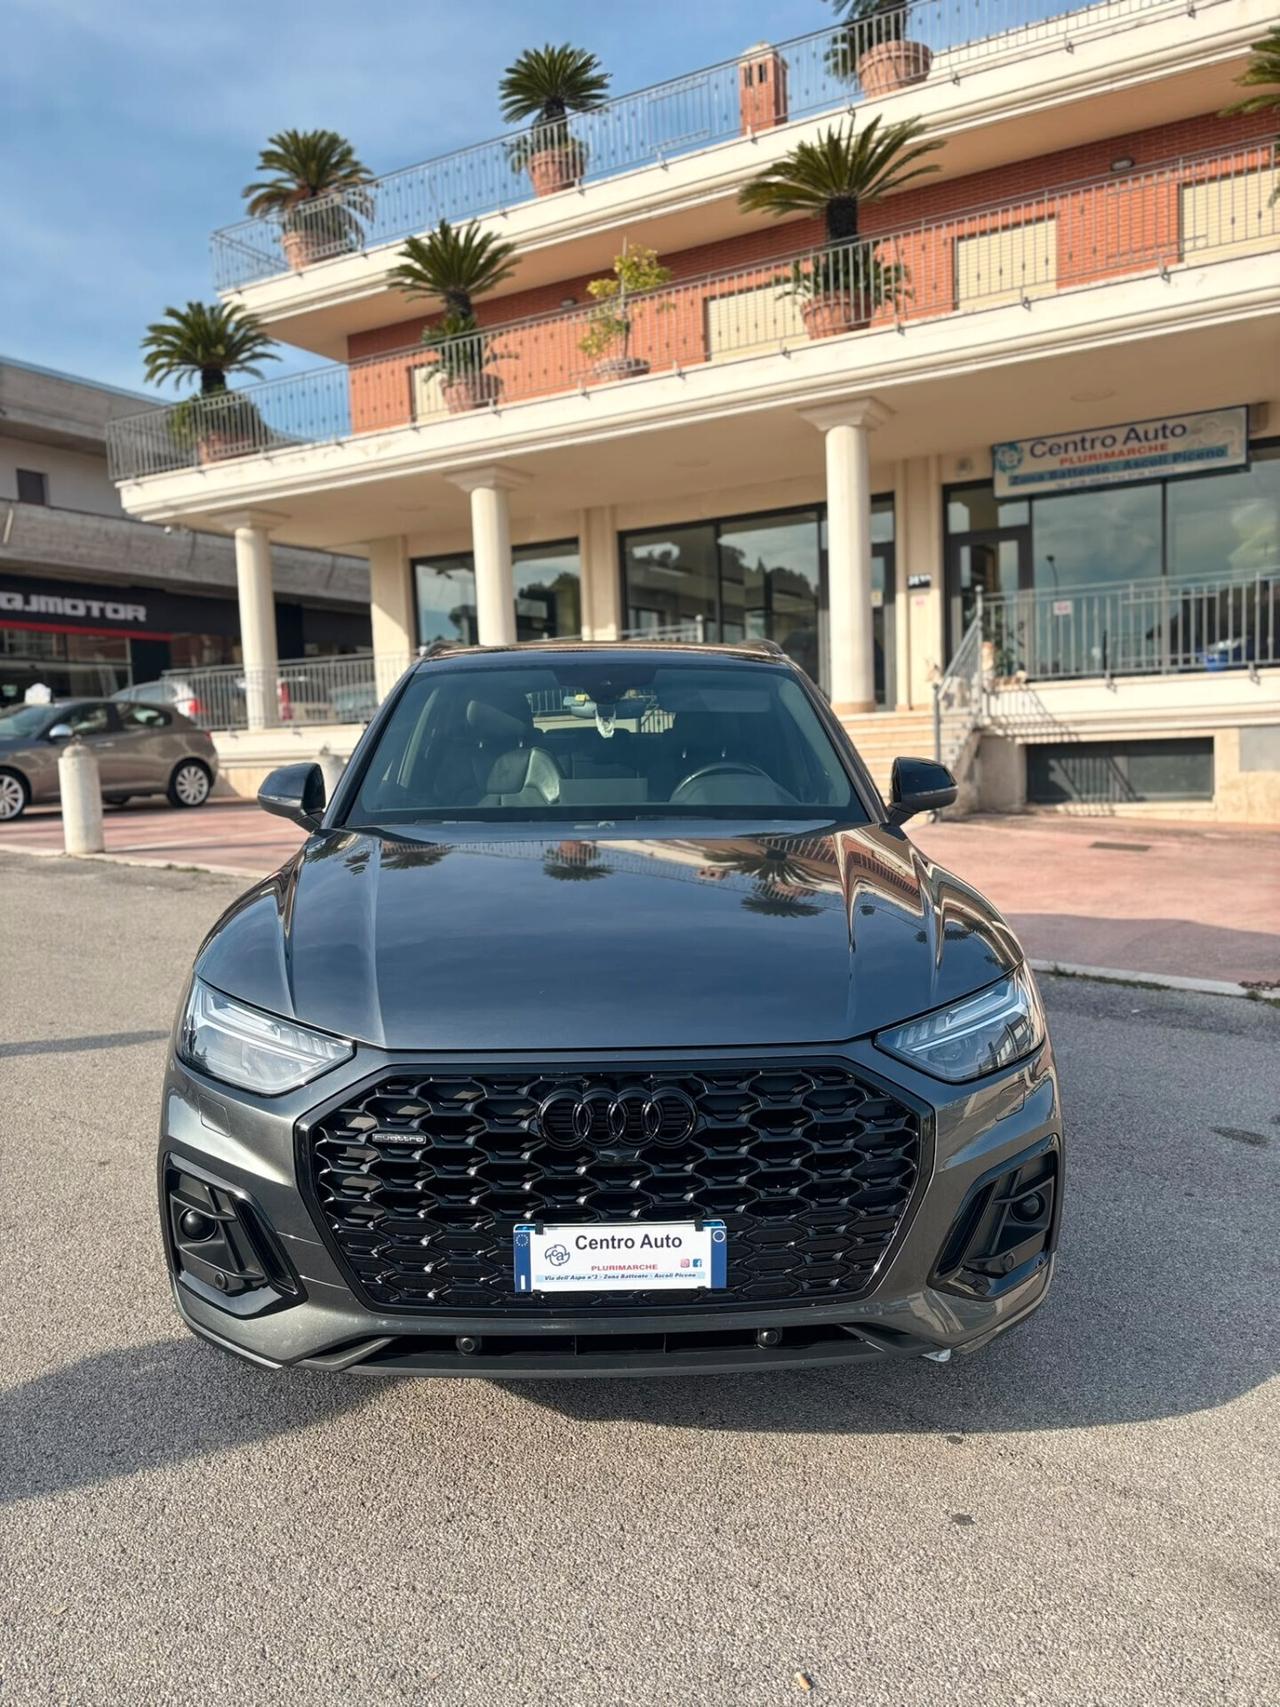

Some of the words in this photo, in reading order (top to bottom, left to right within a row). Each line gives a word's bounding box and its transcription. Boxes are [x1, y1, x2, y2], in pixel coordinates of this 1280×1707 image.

[1030, 435, 1117, 459] Centro
[1122, 423, 1187, 446] Auto
[1059, 442, 1169, 466] PLURIMARCHE
[0, 591, 147, 622] QJMOTOR
[575, 1235, 635, 1250] Centro
[640, 1234, 682, 1249] Auto
